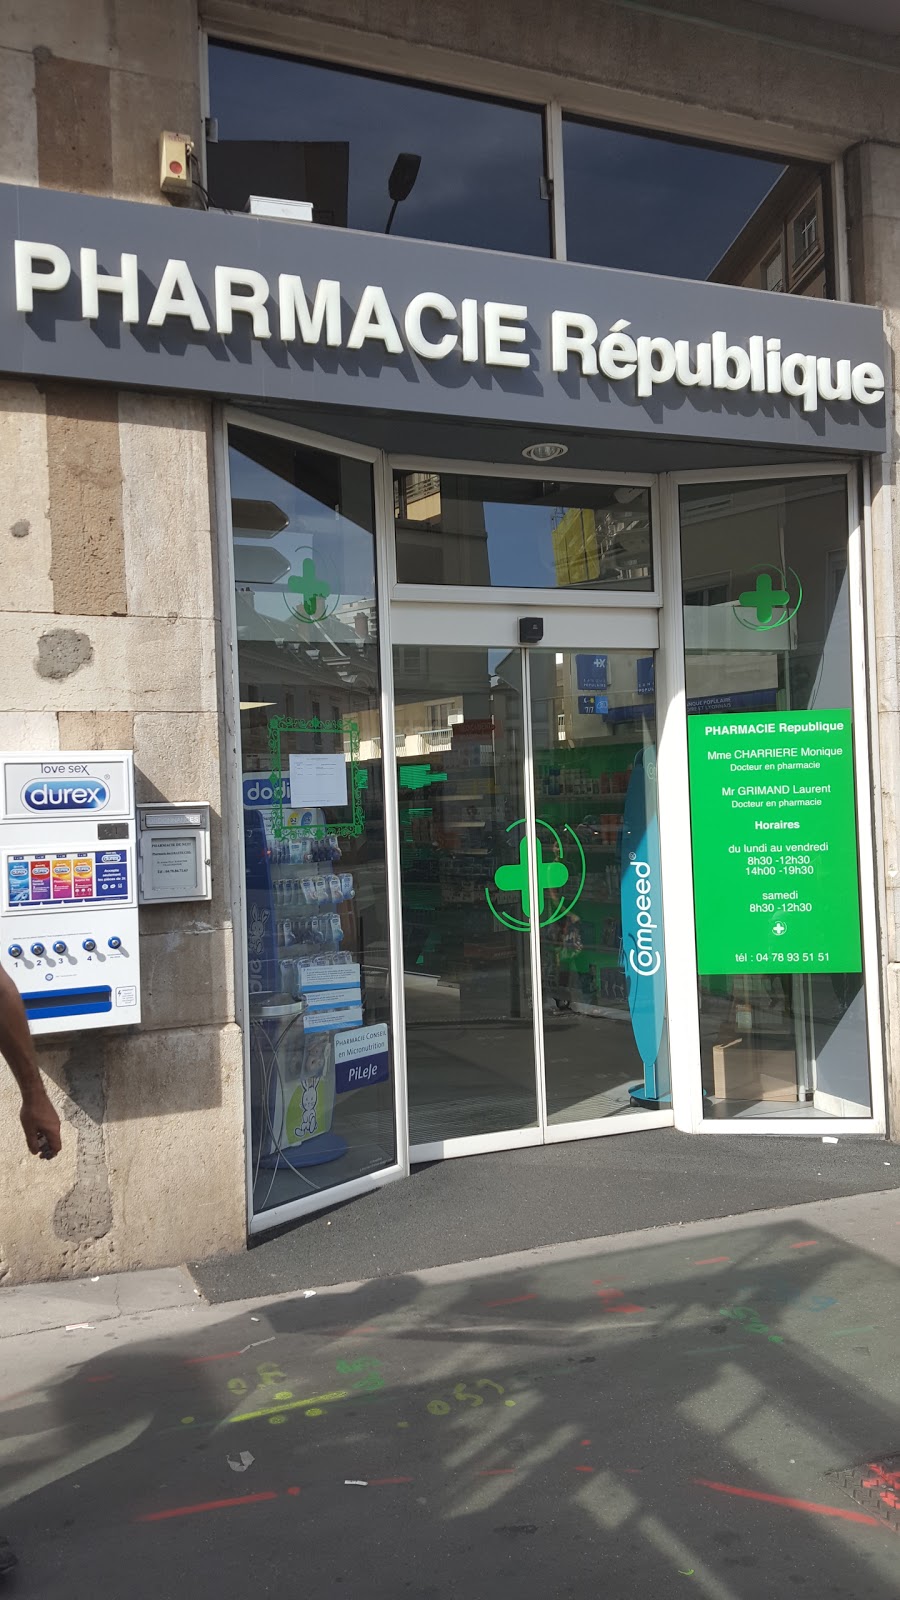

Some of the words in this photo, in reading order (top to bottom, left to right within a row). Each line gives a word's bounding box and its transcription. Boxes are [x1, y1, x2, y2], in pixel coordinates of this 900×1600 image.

[14, 240, 530, 368] PHARMACIE
[551, 309, 885, 412] République
[704, 723, 776, 736] PHARMACIE
[779, 721, 844, 734] Republique
[707, 750, 732, 761] Mme
[734, 748, 798, 760] CHARRIERE
[801, 746, 843, 758] Monique
[40, 763, 66, 774] love
[68, 764, 90, 776] sex
[730, 763, 763, 772] Docteur
[776, 761, 821, 773] pharmacie
[30, 783, 101, 806] durex
[247, 780, 291, 801] dodi
[721, 786, 736, 797] Mr
[737, 785, 790, 796] GRIMAND
[793, 783, 832, 794] Laurent
[731, 799, 764, 808] Docteur
[779, 797, 822, 809] pharmacie
[754, 820, 800, 830] Horaires
[728, 844, 741, 854] du
[743, 843, 768, 853] lundi
[770, 845, 783, 853] au
[785, 842, 829, 852] vendredi
[747, 855, 773, 865] 8h30
[745, 866, 776, 875] 14h00
[762, 890, 799, 900] samedi
[749, 903, 775, 912] 8h30
[629, 861, 661, 976] Compeed
[735, 953, 748, 963] tél
[756, 952, 769, 962] 04
[771, 952, 785, 962] 78
[786, 952, 800, 962] 93
[802, 952, 815, 962] 51
[817, 952, 830, 962] 51
[336, 1035, 365, 1047] PHARMACIE
[366, 1030, 387, 1040] CONSEIL
[338, 1051, 346, 1059] en
[346, 1041, 385, 1056] Micronutrition
[348, 1063, 378, 1082] PiLeJe
